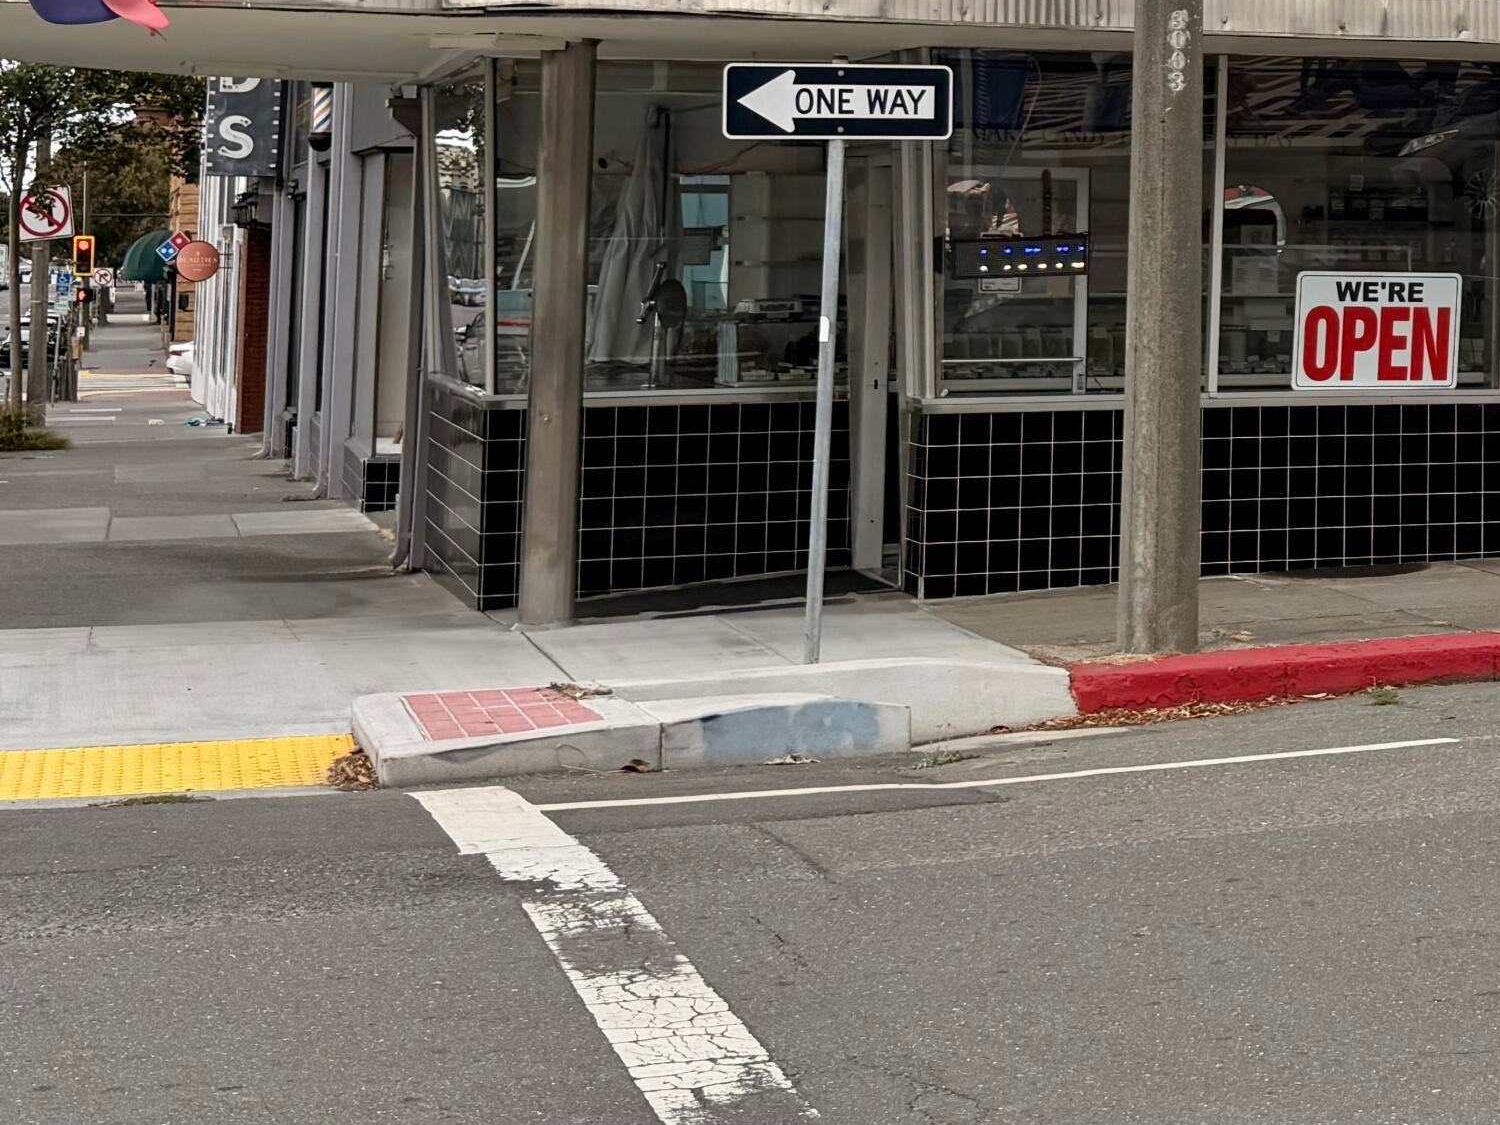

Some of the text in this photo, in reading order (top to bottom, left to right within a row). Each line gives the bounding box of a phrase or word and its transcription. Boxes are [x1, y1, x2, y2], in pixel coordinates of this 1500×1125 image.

[795, 87, 927, 115] ONE WAY
[1335, 281, 1424, 303] WE'RE
[1302, 305, 1451, 381] OPEN
